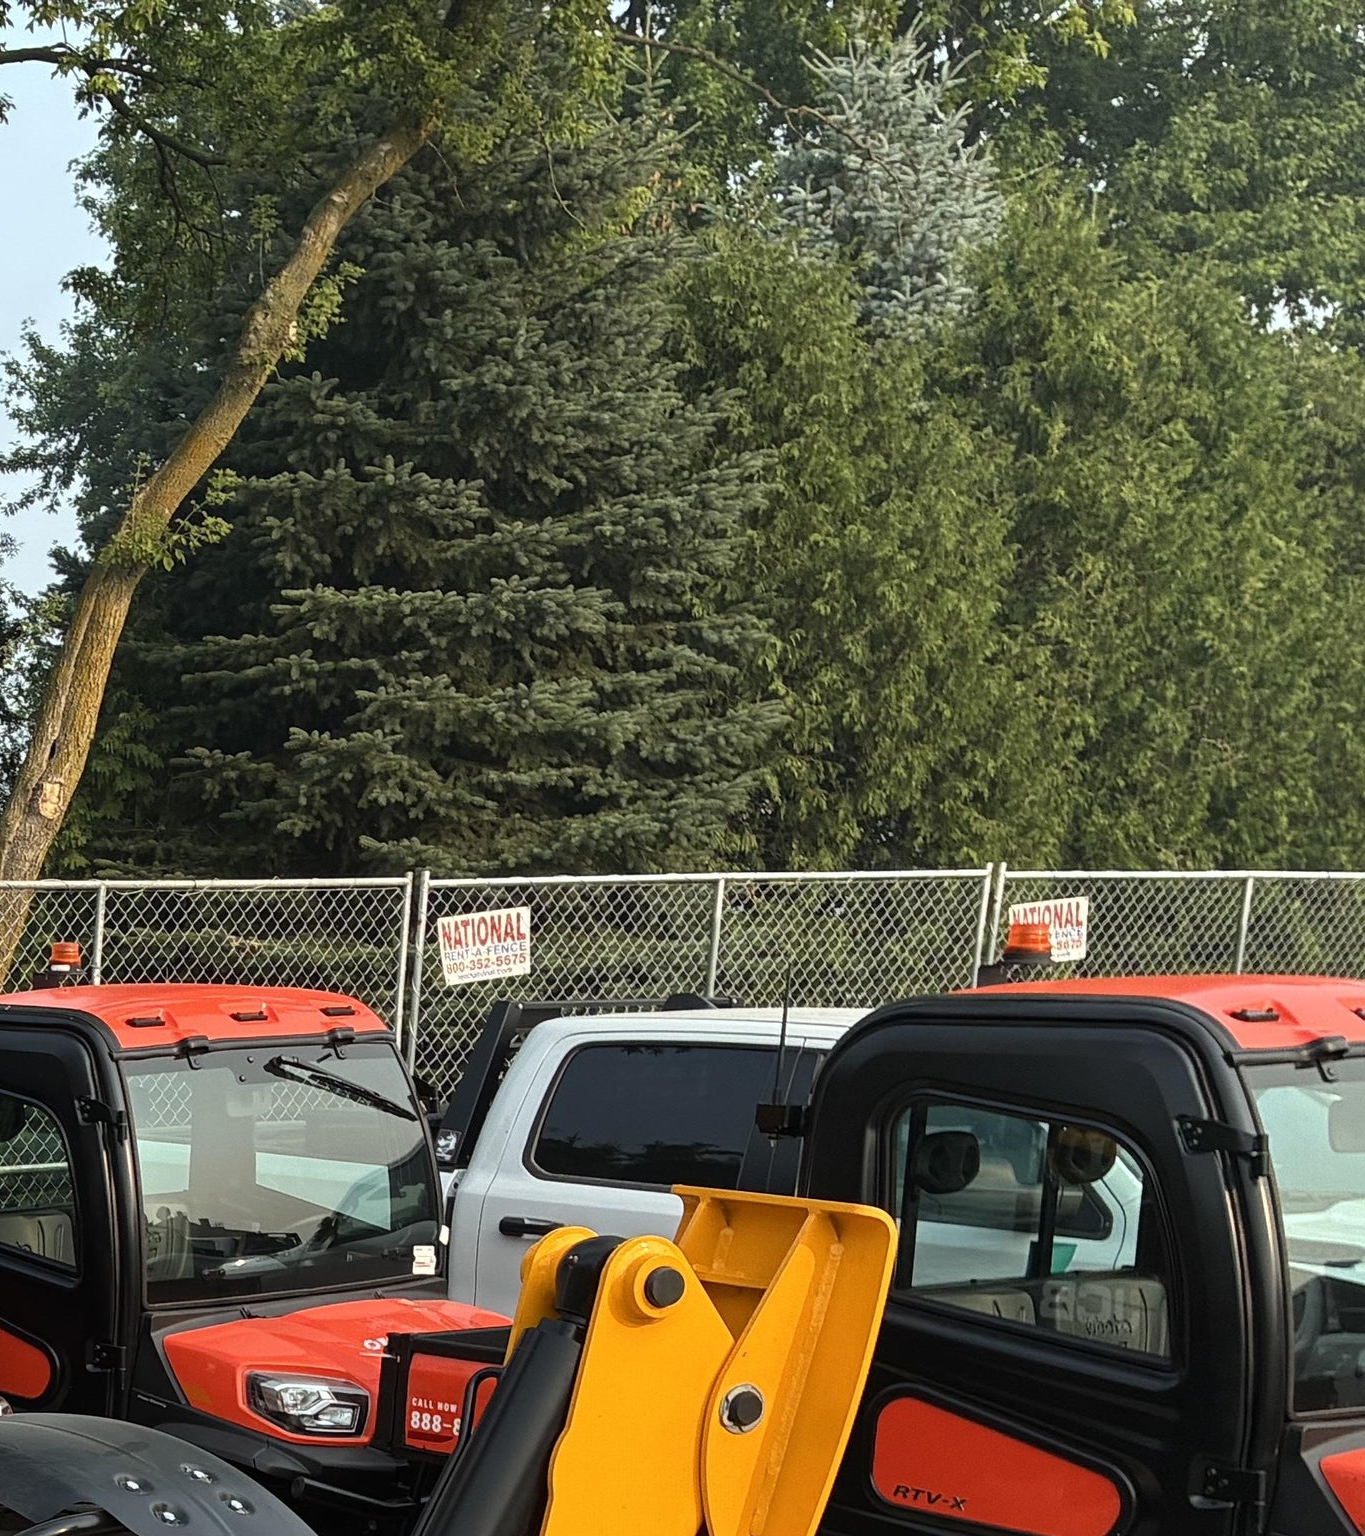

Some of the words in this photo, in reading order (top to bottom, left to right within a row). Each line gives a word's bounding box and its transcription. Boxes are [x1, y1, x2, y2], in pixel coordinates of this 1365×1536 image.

[441, 913, 526, 951] NATIONAL
[444, 941, 527, 961] RENT-A-FENCE
[446, 953, 527, 975] 800-352-5675
[412, 1397, 434, 1409] CALL
[437, 1402, 457, 1413] NOW
[410, 1411, 462, 1436] 888-8
[893, 1485, 966, 1511] RTV-X
